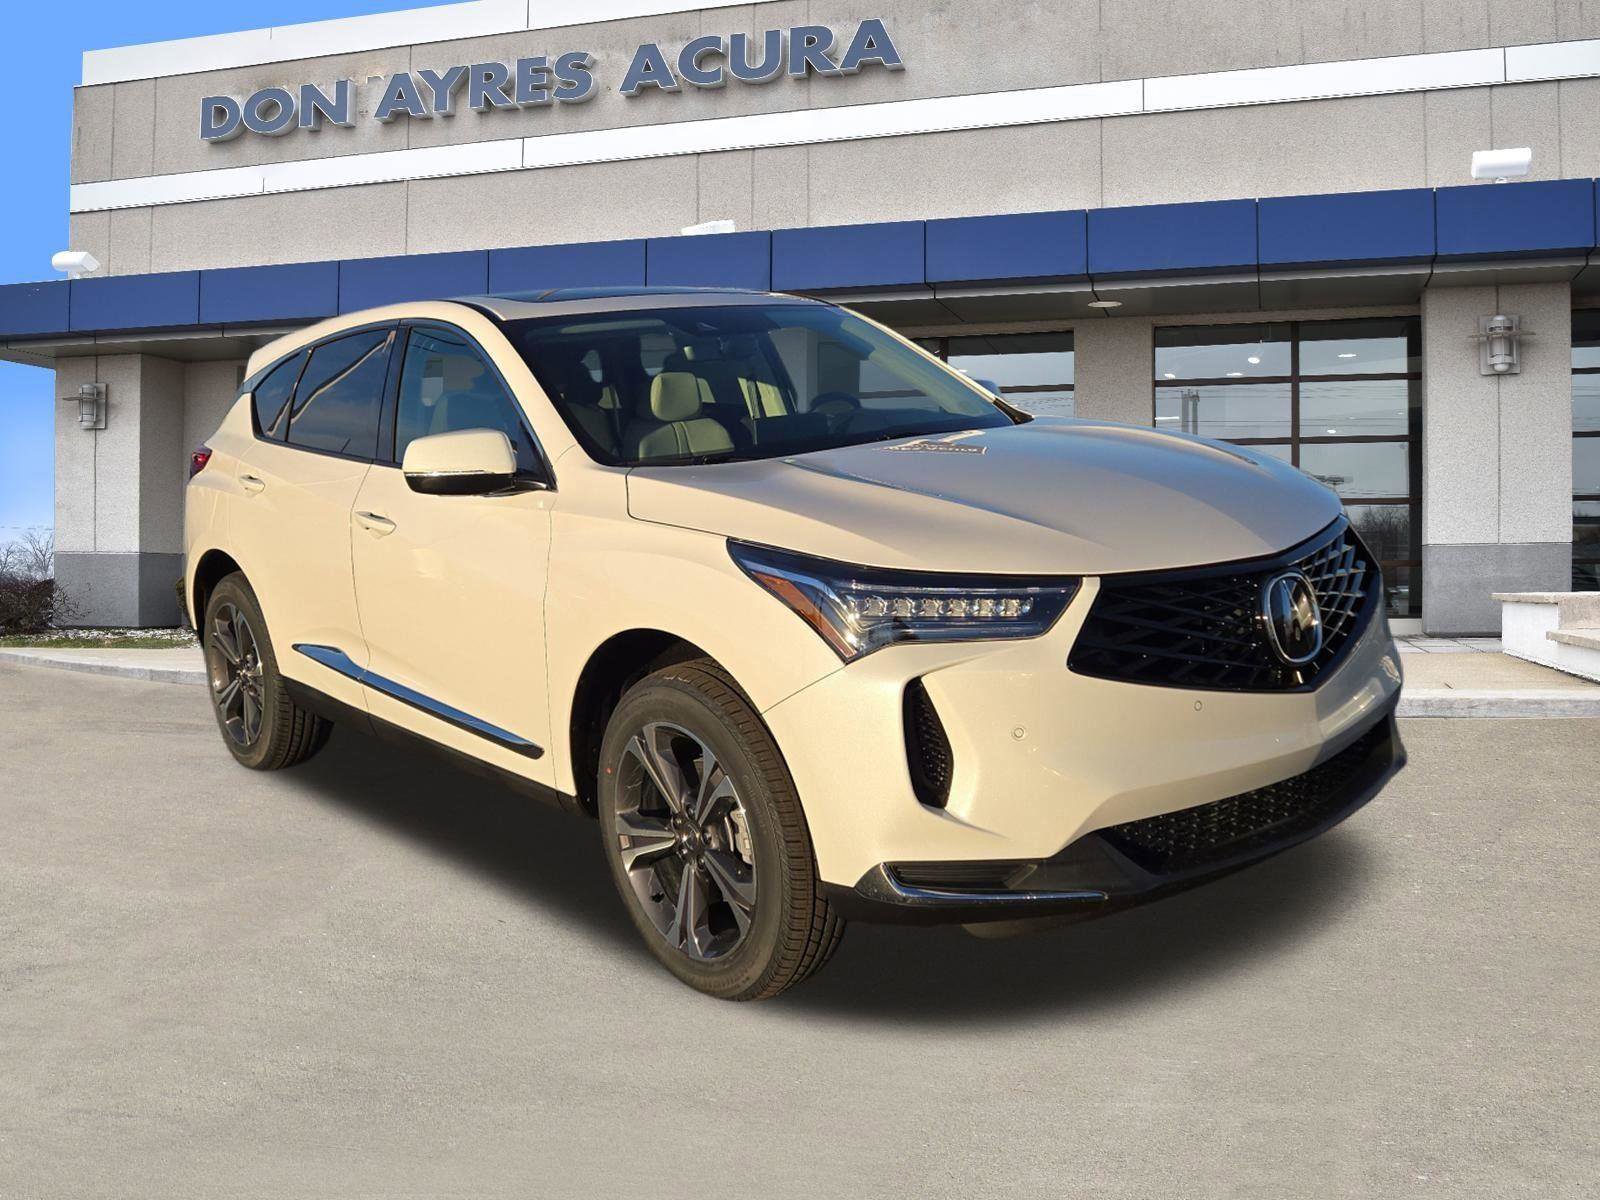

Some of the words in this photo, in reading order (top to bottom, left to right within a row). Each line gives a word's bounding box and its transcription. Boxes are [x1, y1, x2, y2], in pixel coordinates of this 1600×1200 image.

[200, 80, 355, 142] DON
[374, 51, 598, 124] AYRES
[619, 17, 905, 97] ACURA
